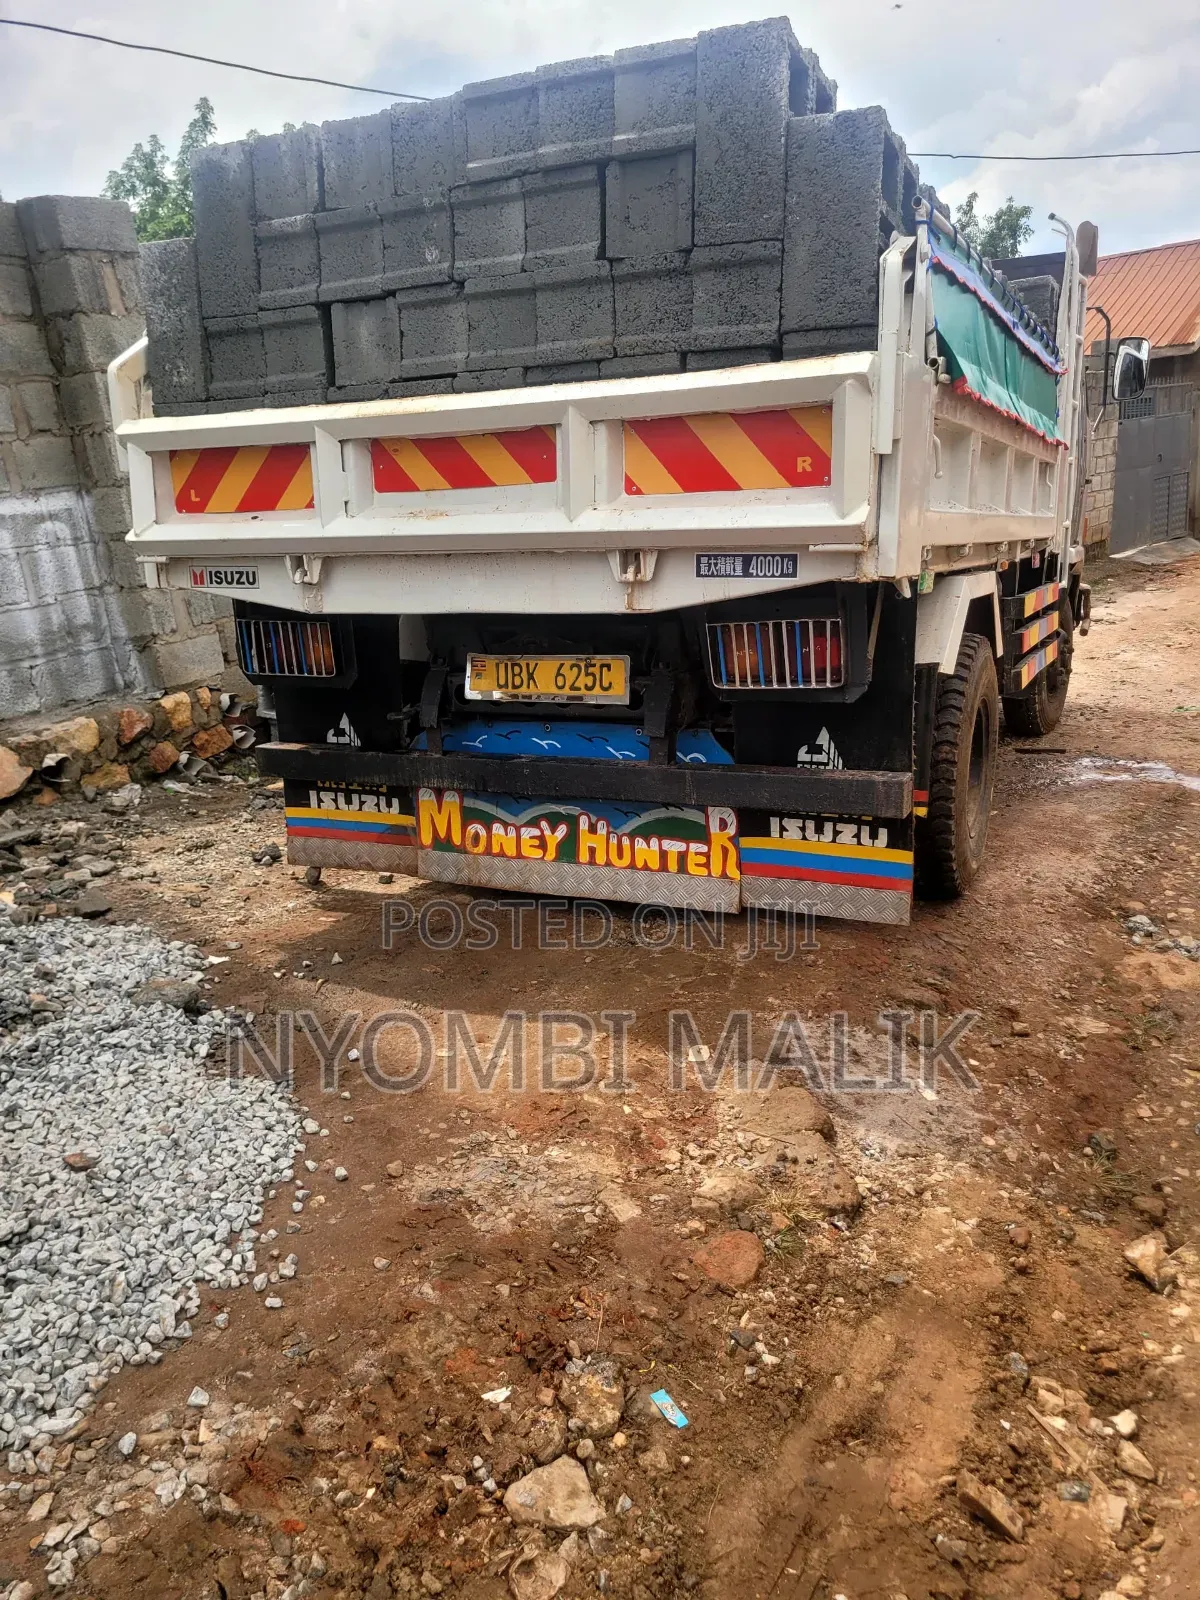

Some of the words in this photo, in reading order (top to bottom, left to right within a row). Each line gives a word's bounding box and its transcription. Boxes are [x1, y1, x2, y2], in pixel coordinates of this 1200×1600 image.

[797, 456, 812, 472] R
[190, 489, 201, 502] L
[748, 555, 781, 576] 4000
[208, 570, 257, 586] ISUZU
[495, 662, 540, 690] UBK
[554, 662, 613, 692] 625C
[308, 790, 400, 814] ISUZU
[417, 786, 568, 862] MONEY
[576, 806, 741, 881] HUNTER
[769, 816, 888, 848] ISUZU
